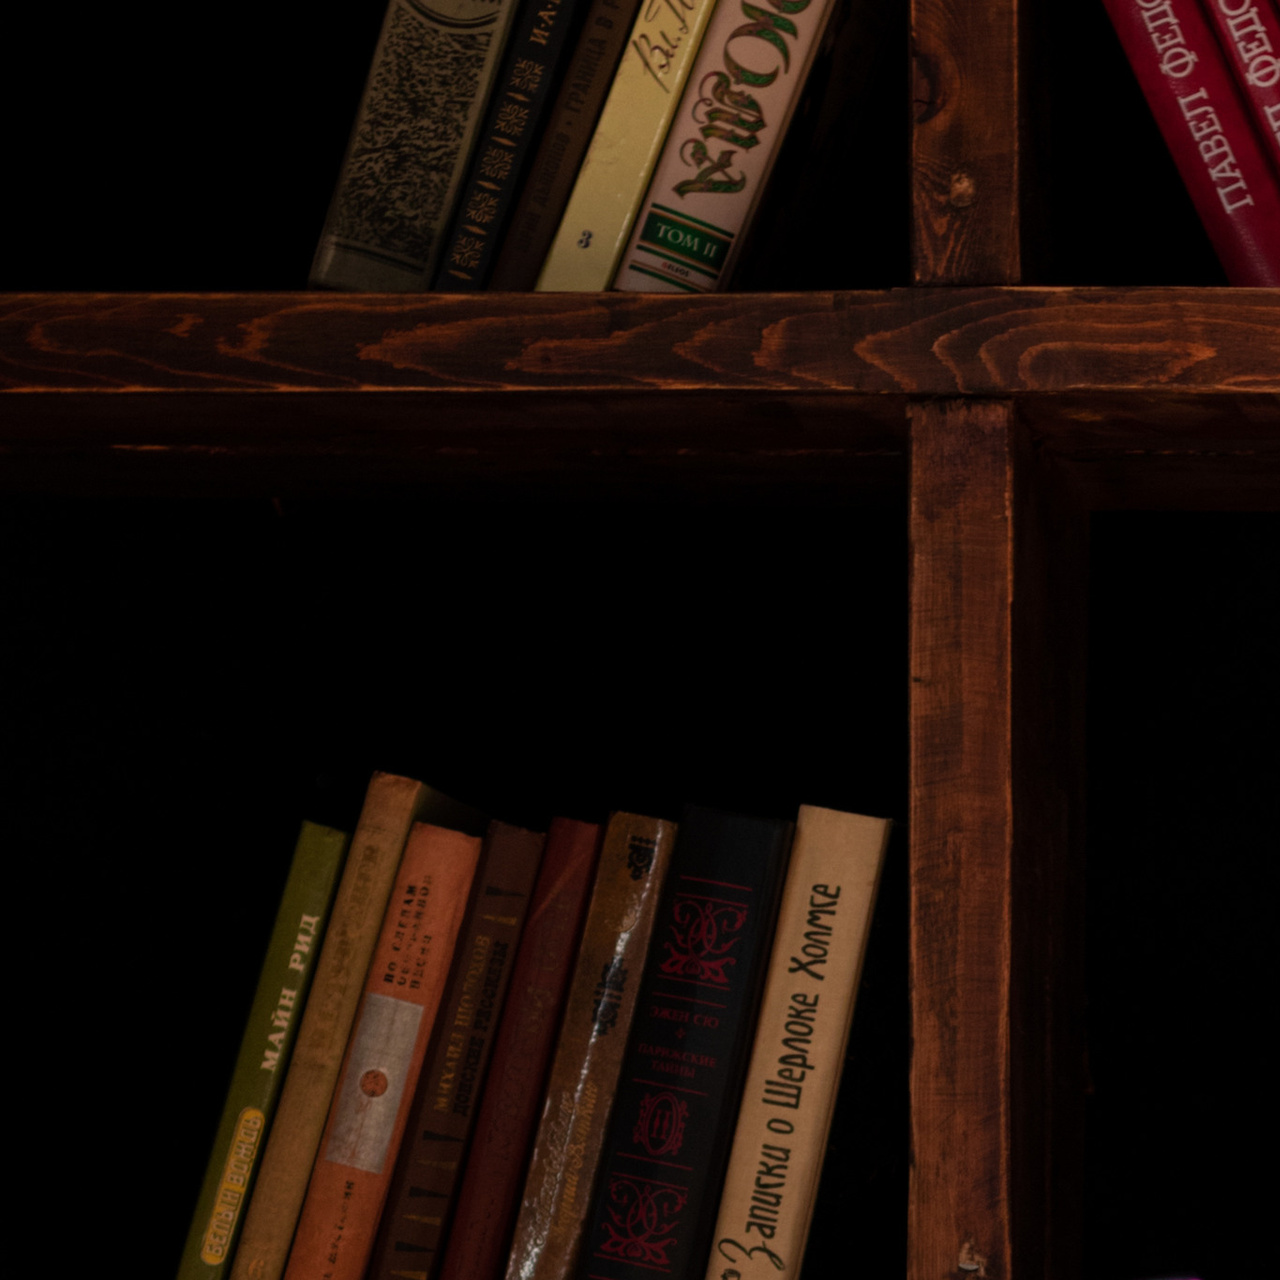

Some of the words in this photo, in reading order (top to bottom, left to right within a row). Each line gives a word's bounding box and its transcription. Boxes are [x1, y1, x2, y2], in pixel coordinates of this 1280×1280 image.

[568, 37, 608, 115] ГРАНИЦА
[1177, 87, 1255, 215] ПАВЕЛ
[577, 230, 592, 249] 3
[656, 222, 701, 252] ТОМ
[703, 241, 719, 258] II
[788, 882, 843, 981] Холмсе
[260, 986, 298, 1074] МАЙН
[289, 912, 320, 972] РИД
[649, 1004, 690, 1024] ЭЖЕН
[692, 1012, 720, 1031] СЮ
[637, 1043, 718, 1070] ПАРИЖСКИЕ
[761, 992, 821, 1110] Шерлоке
[652, 1108, 671, 1141] II
[767, 1117, 795, 1137] о
[716, 1144, 793, 1272] Записки
